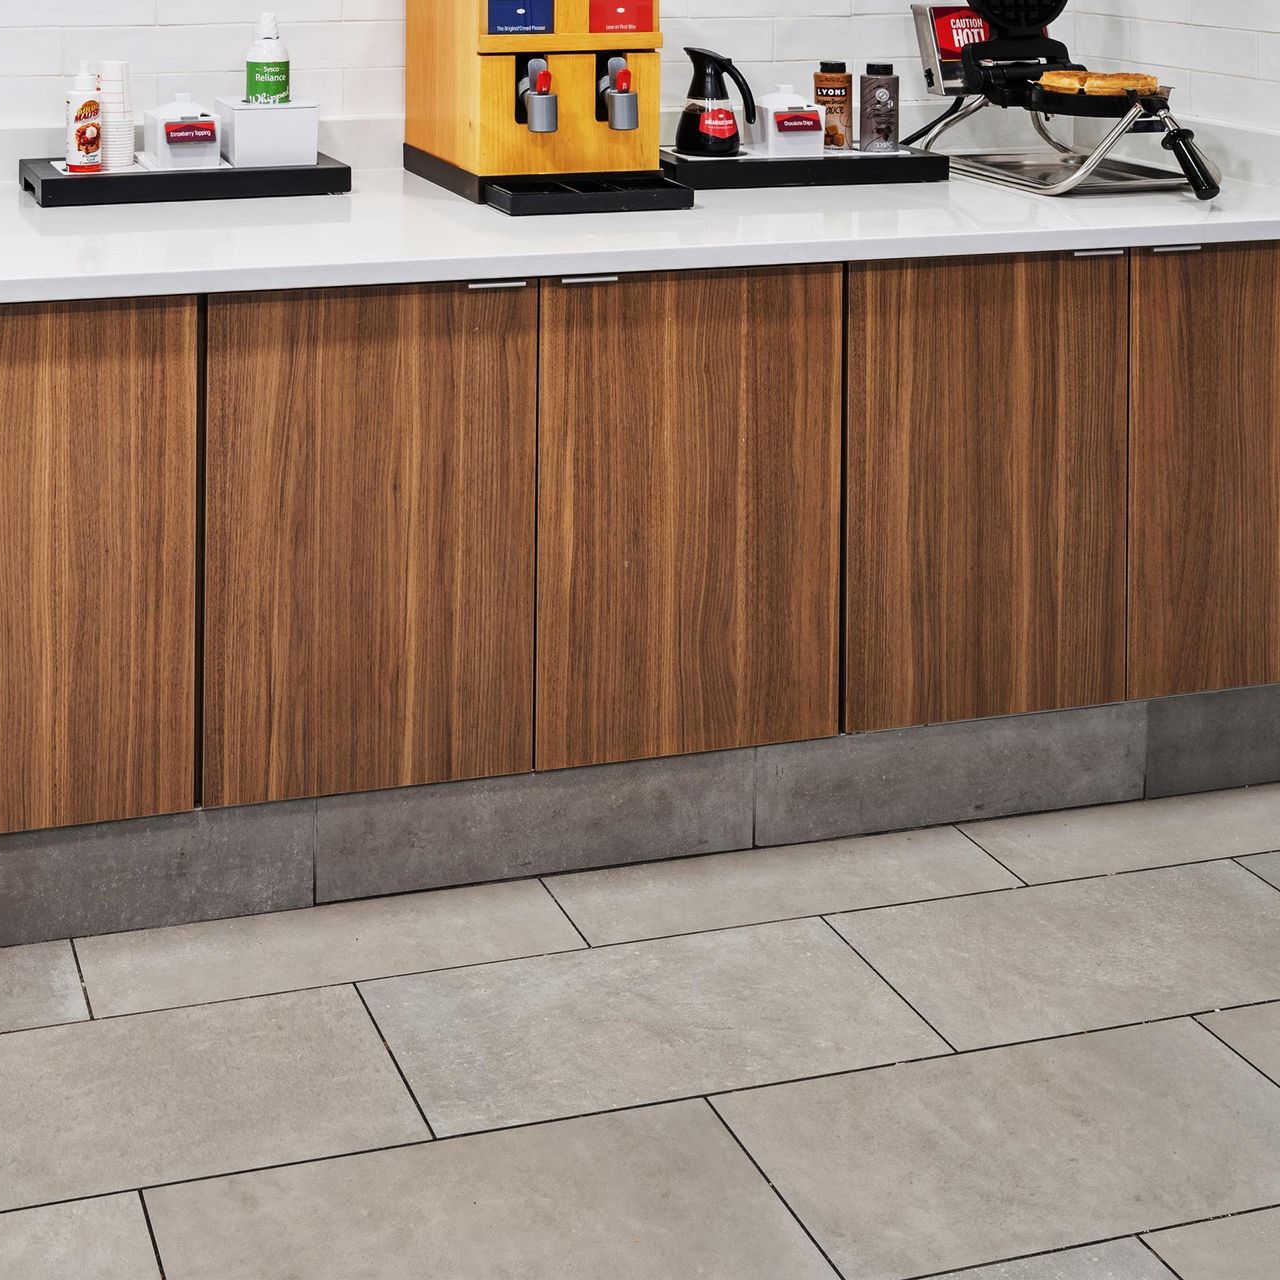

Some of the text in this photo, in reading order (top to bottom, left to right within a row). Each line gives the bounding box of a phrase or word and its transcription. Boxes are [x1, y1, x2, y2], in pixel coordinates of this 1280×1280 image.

[950, 18, 984, 29] CAUTION
[263, 65, 280, 73] Sysco
[255, 73, 287, 81] Reliance
[817, 88, 846, 96] LYONS
